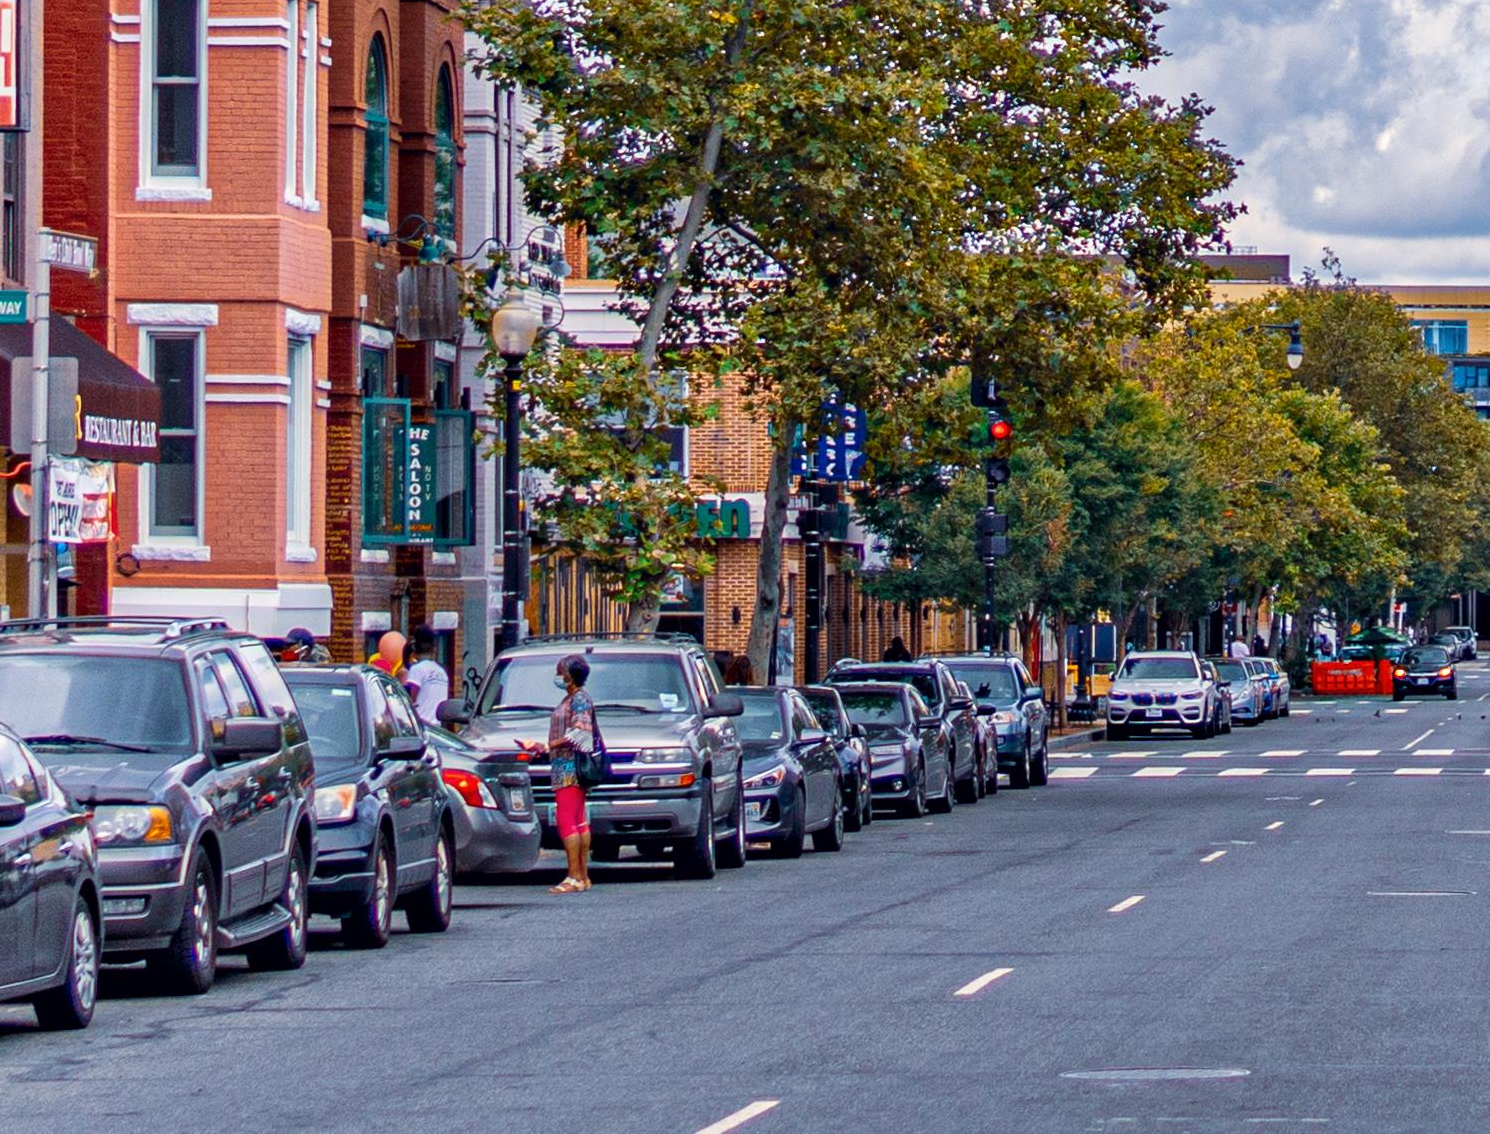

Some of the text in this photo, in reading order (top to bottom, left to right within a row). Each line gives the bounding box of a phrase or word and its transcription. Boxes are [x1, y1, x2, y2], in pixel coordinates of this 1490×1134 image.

[84, 414, 131, 446] RESTAURANT
[141, 421, 157, 448] BAR
[408, 443, 422, 521] SALOON
